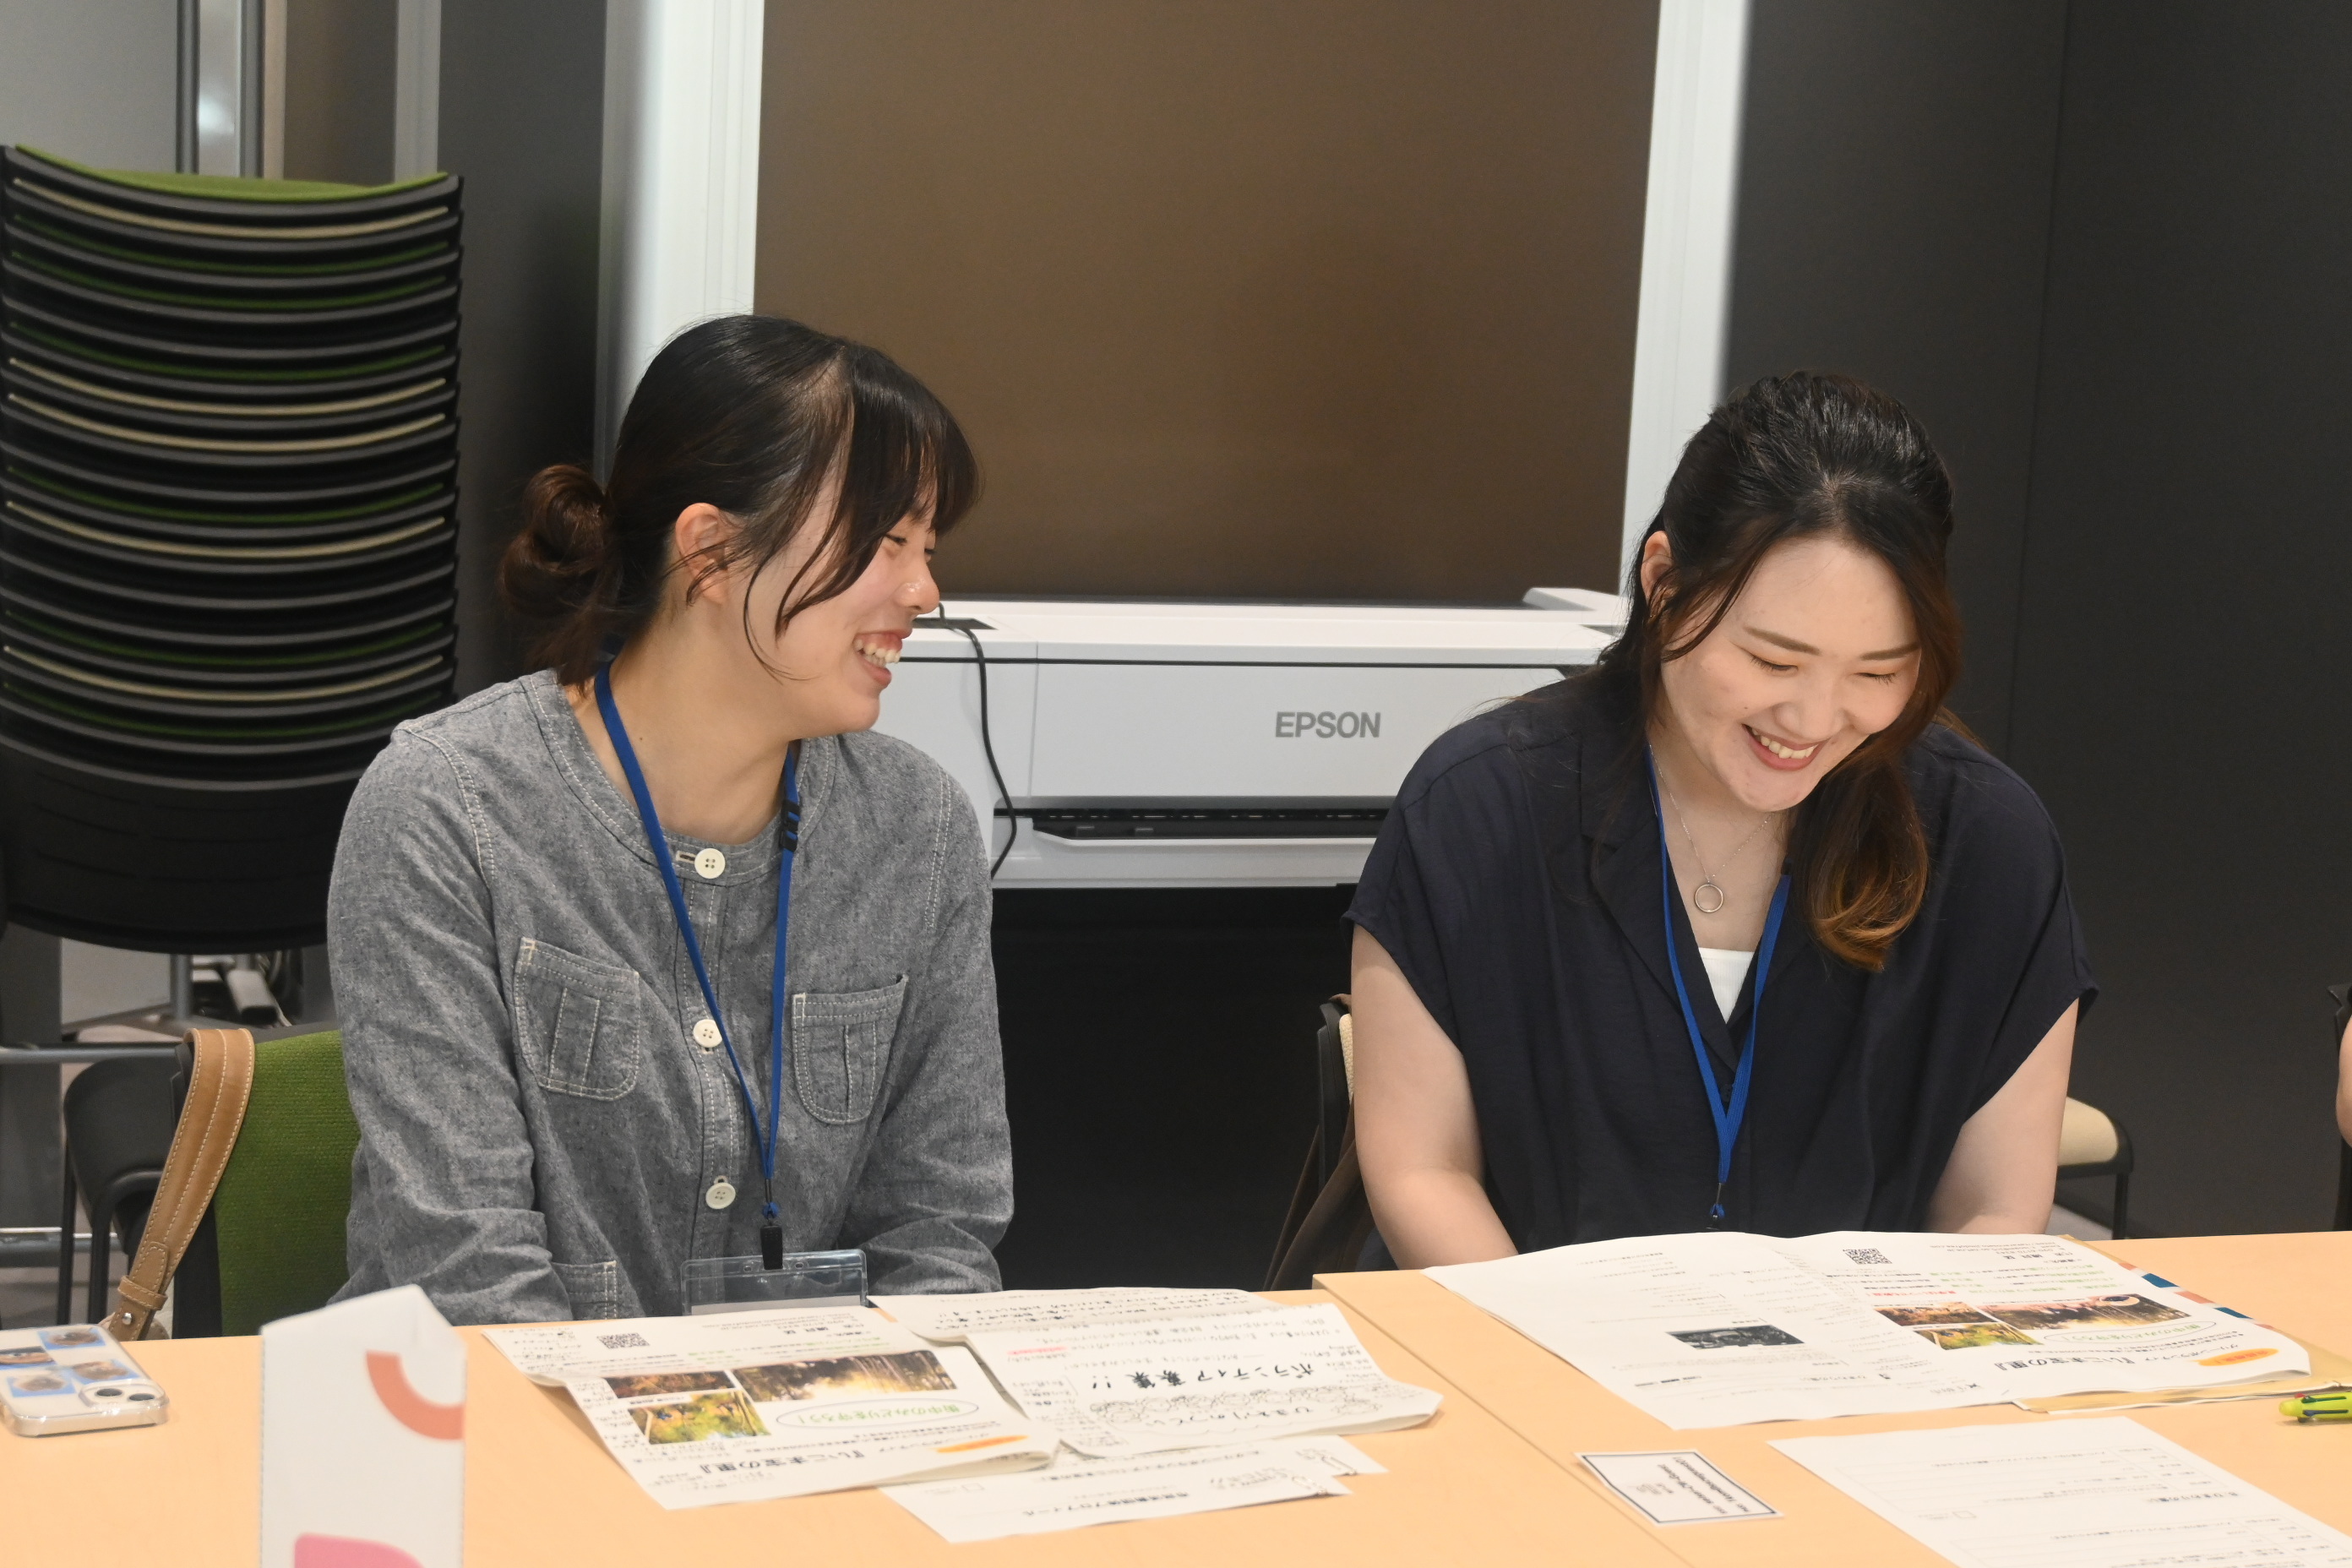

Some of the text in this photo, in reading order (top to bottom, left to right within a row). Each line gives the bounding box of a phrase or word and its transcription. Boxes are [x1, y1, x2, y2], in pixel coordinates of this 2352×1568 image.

[1276, 711, 1381, 738] EPSON
[1196, 1363, 1314, 1384] ボランティア
